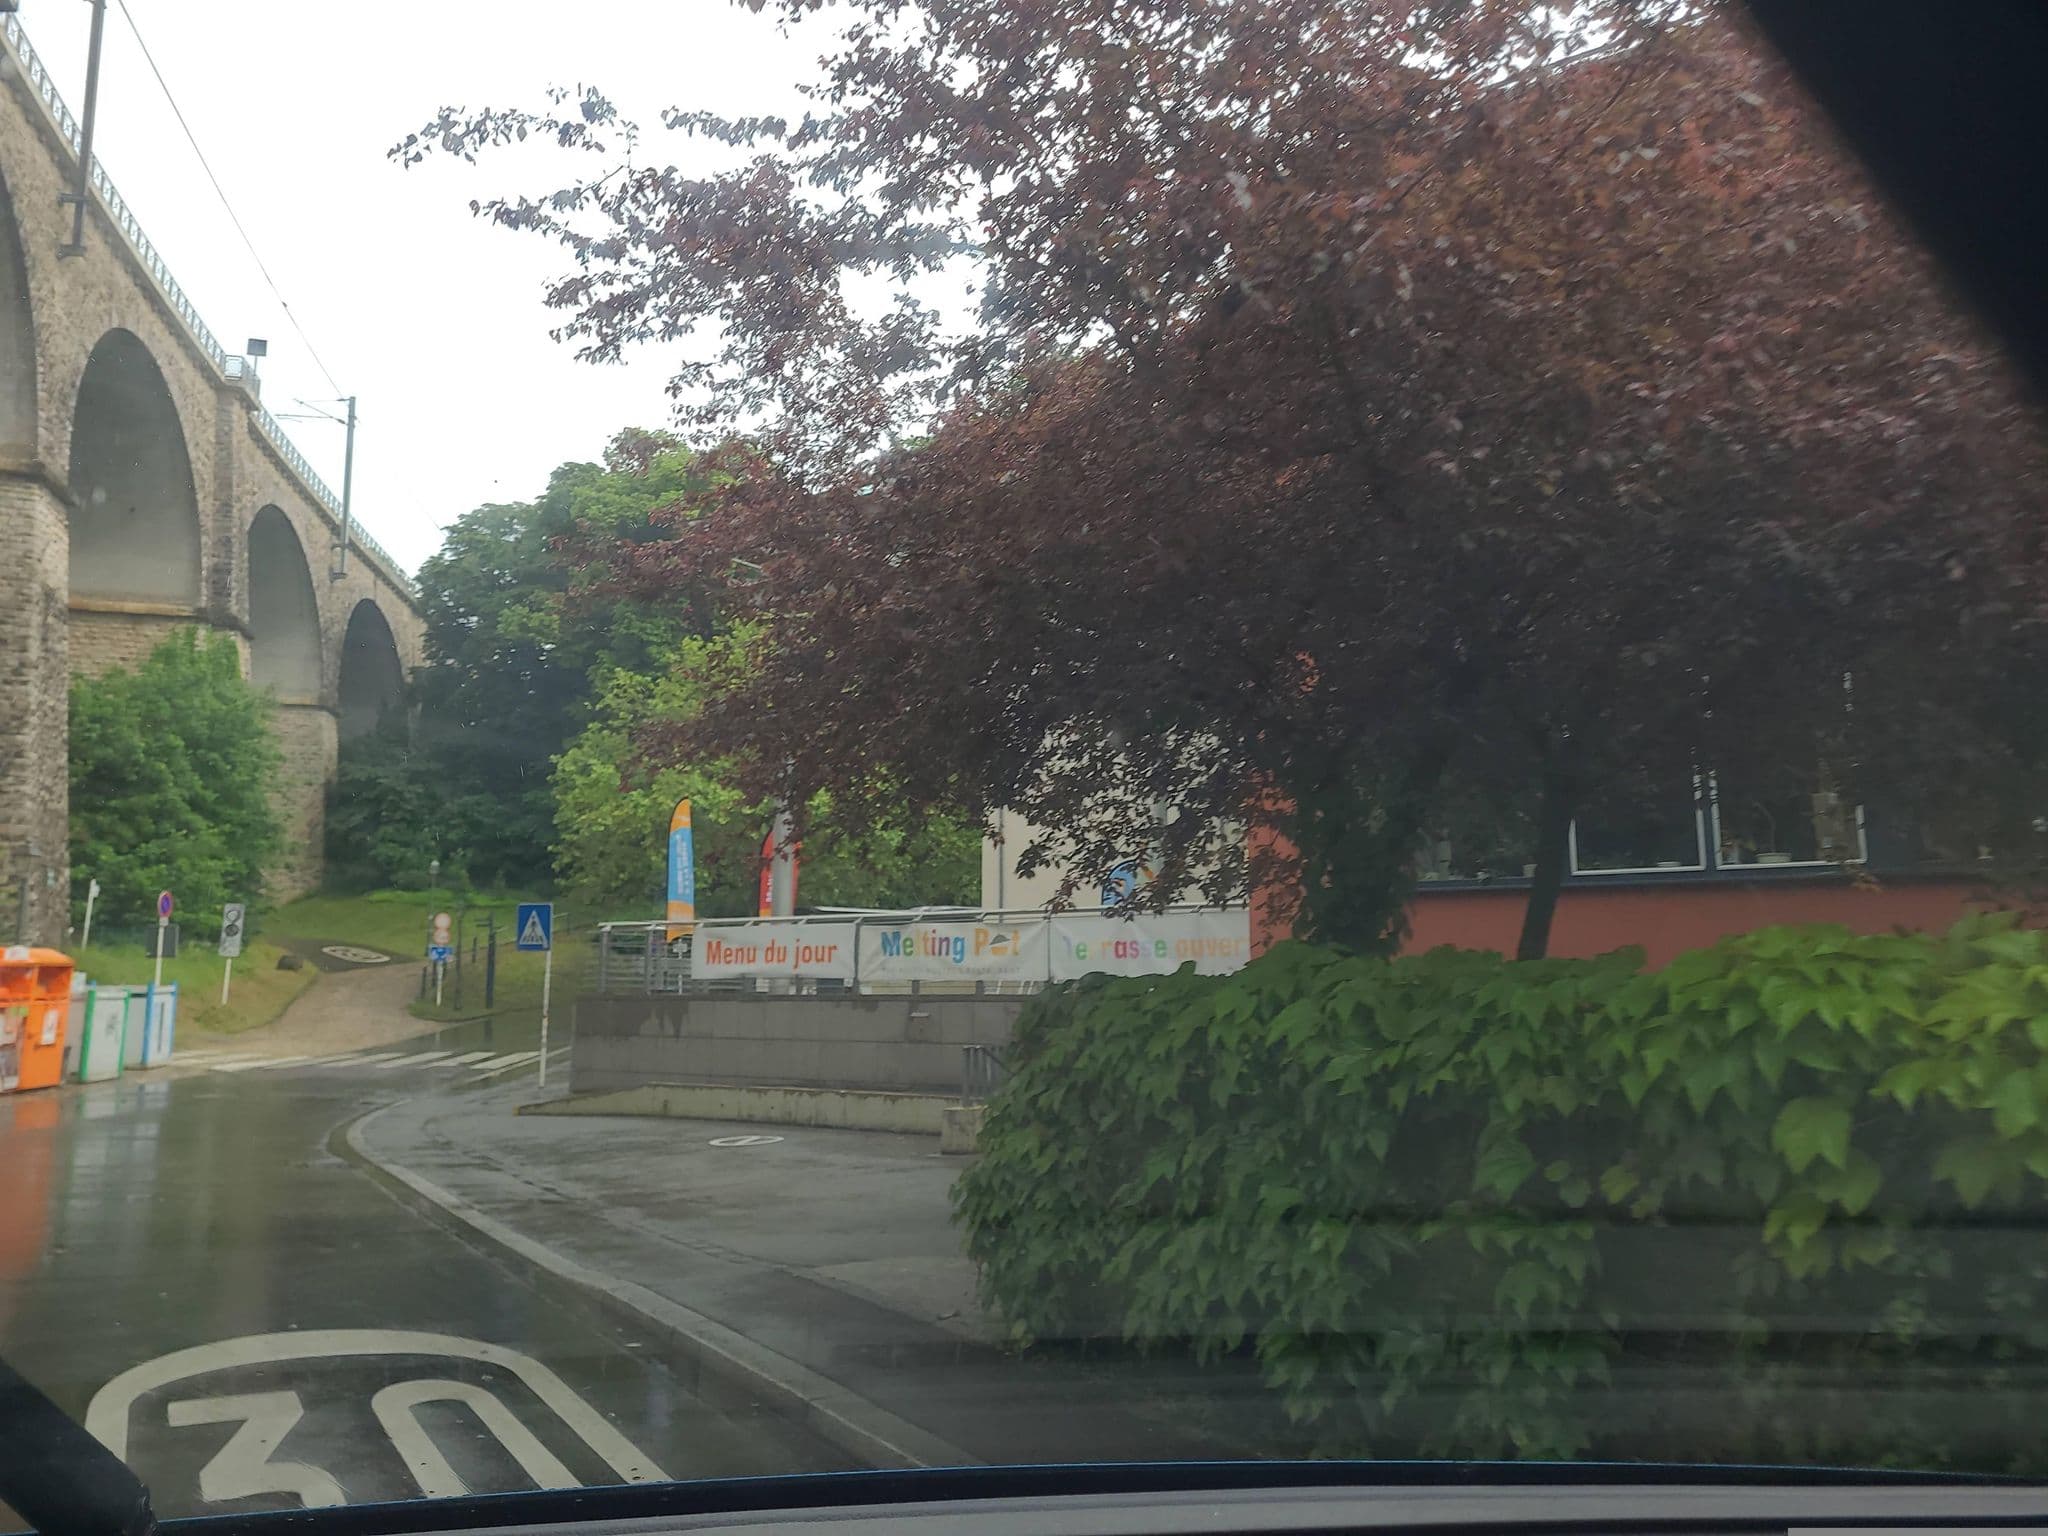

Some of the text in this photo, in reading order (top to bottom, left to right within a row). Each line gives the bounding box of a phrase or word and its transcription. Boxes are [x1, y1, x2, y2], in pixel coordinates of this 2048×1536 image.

[705, 938, 838, 969] Menu du jour
[880, 927, 1022, 964] Melting Pot
[166, 1379, 584, 1509] 30
